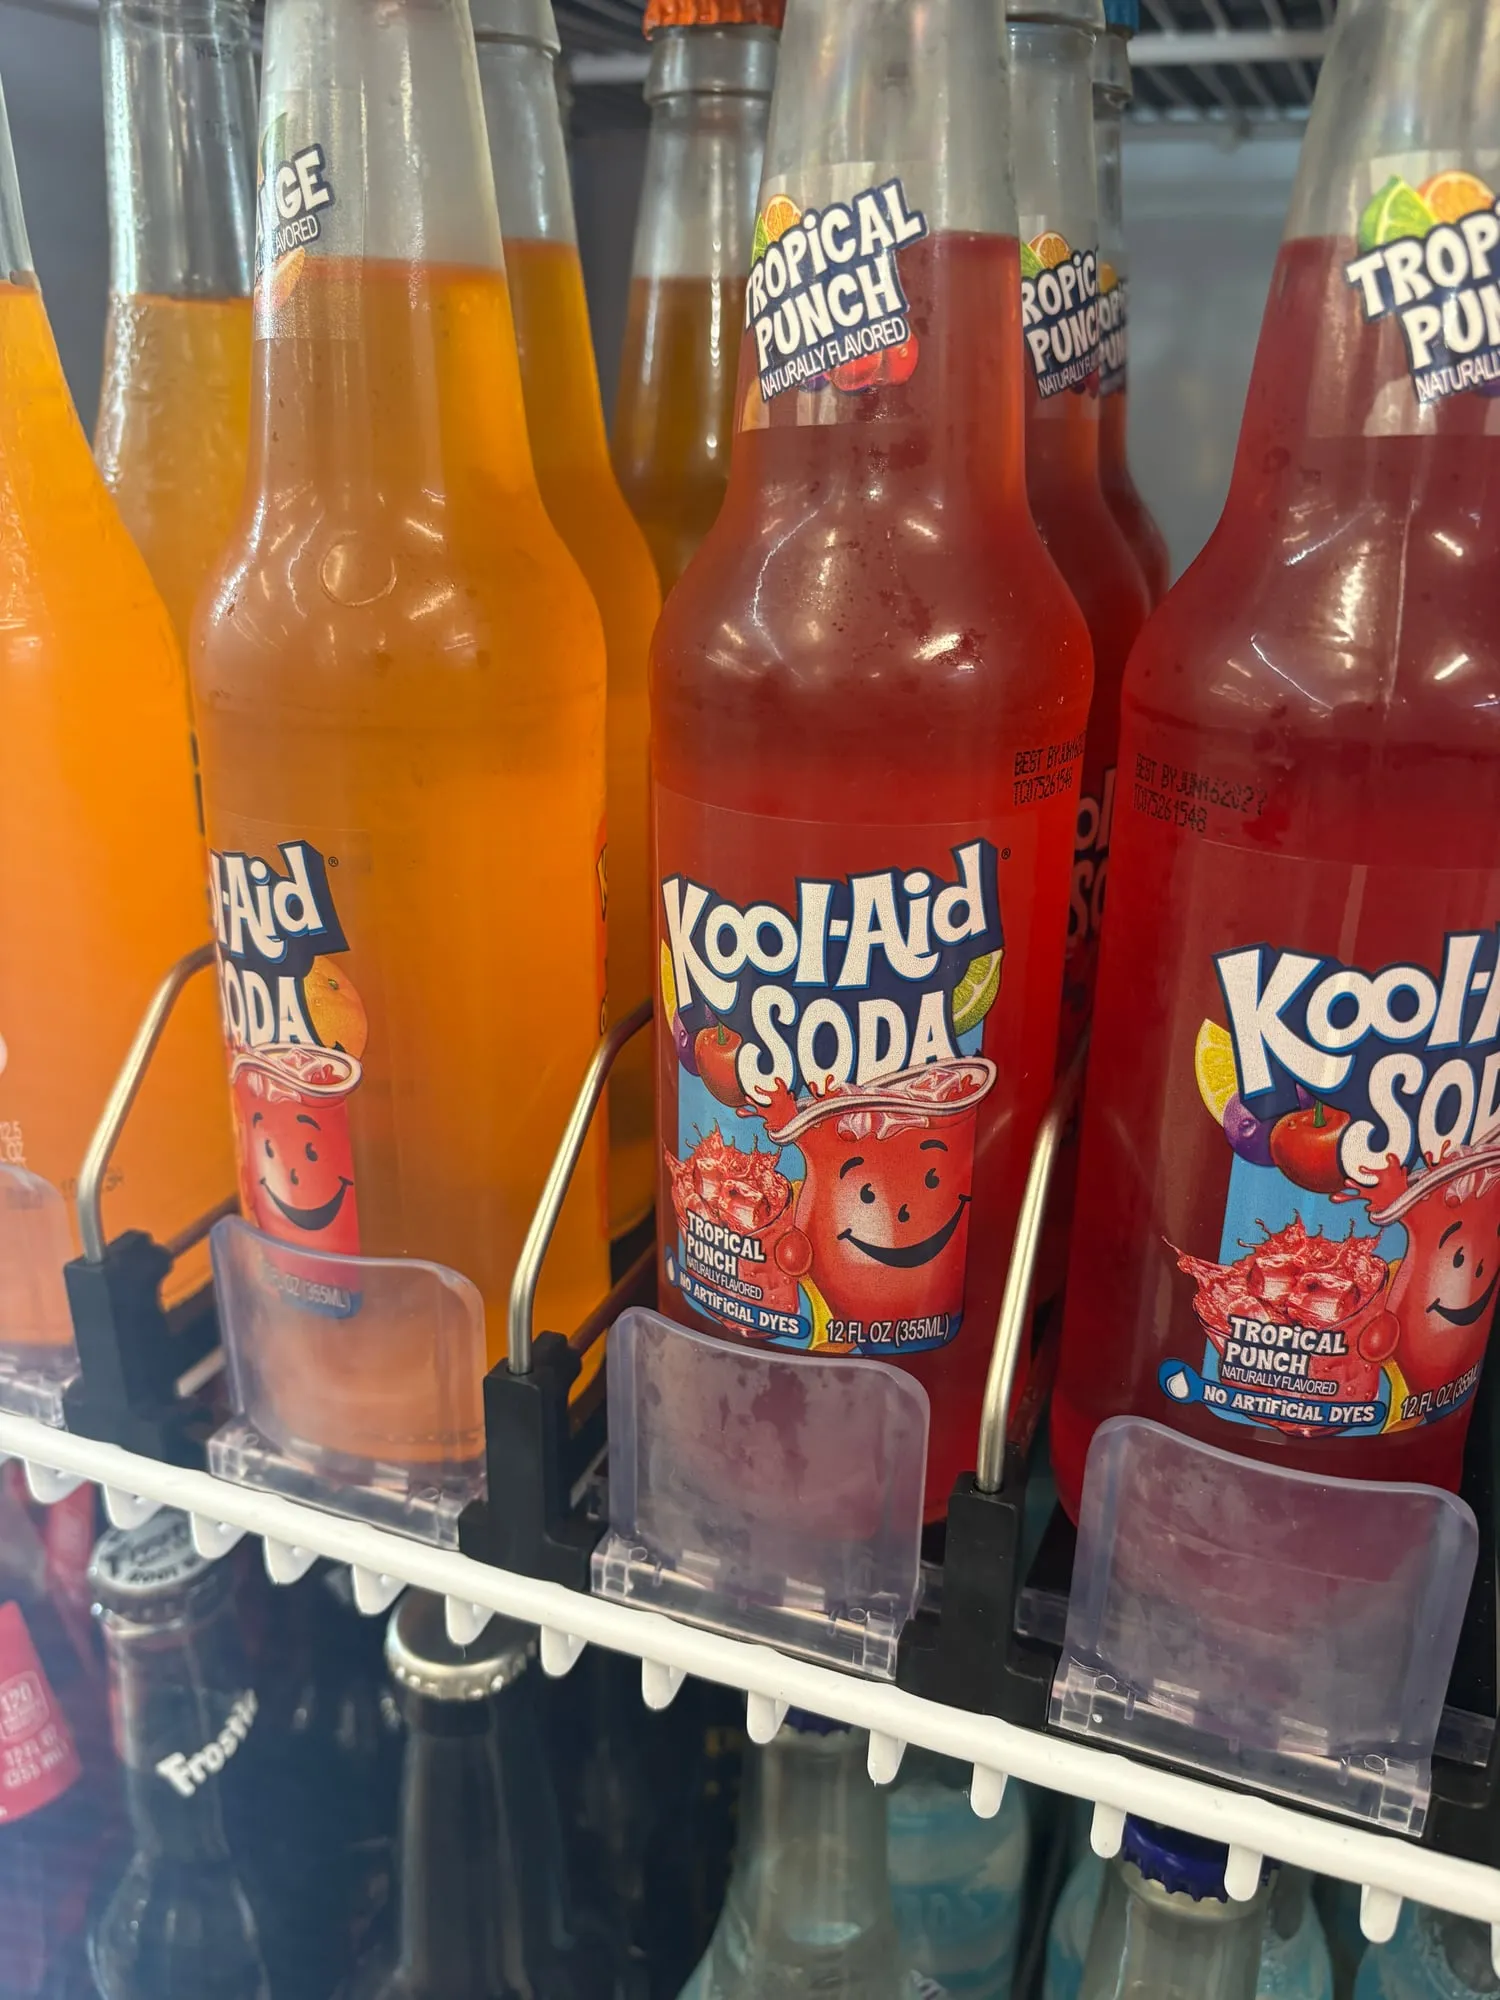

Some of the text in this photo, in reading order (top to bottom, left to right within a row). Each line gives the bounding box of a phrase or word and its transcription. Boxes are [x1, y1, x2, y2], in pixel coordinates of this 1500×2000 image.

[754, 255, 902, 371] PUNCH
[1026, 303, 1099, 373] PUNC
[1402, 284, 1500, 369] PUN
[760, 316, 906, 400] NATURALLY FLAVORED
[1014, 748, 1044, 778] BEST
[662, 841, 988, 1011] Kool-Aid
[222, 960, 315, 1047] ODA
[737, 984, 956, 1105] SODA
[686, 1255, 762, 1299] NATURALLY FLAVORED
[687, 1234, 737, 1276] PUNCH
[680, 1271, 692, 1291] NO
[759, 1312, 800, 1335] DYES
[826, 1314, 949, 1346] 12 FL OZ (355ML)
[1221, 1363, 1338, 1396] NATURALLY FLAVORED
[1224, 1342, 1309, 1375] PUNCH
[1203, 1385, 1228, 1405] NO
[1329, 1406, 1375, 1424] DYES
[1402, 1396, 1418, 1420] 12
[1418, 1391, 1433, 1415] FL
[1436, 1383, 1454, 1408] OZ
